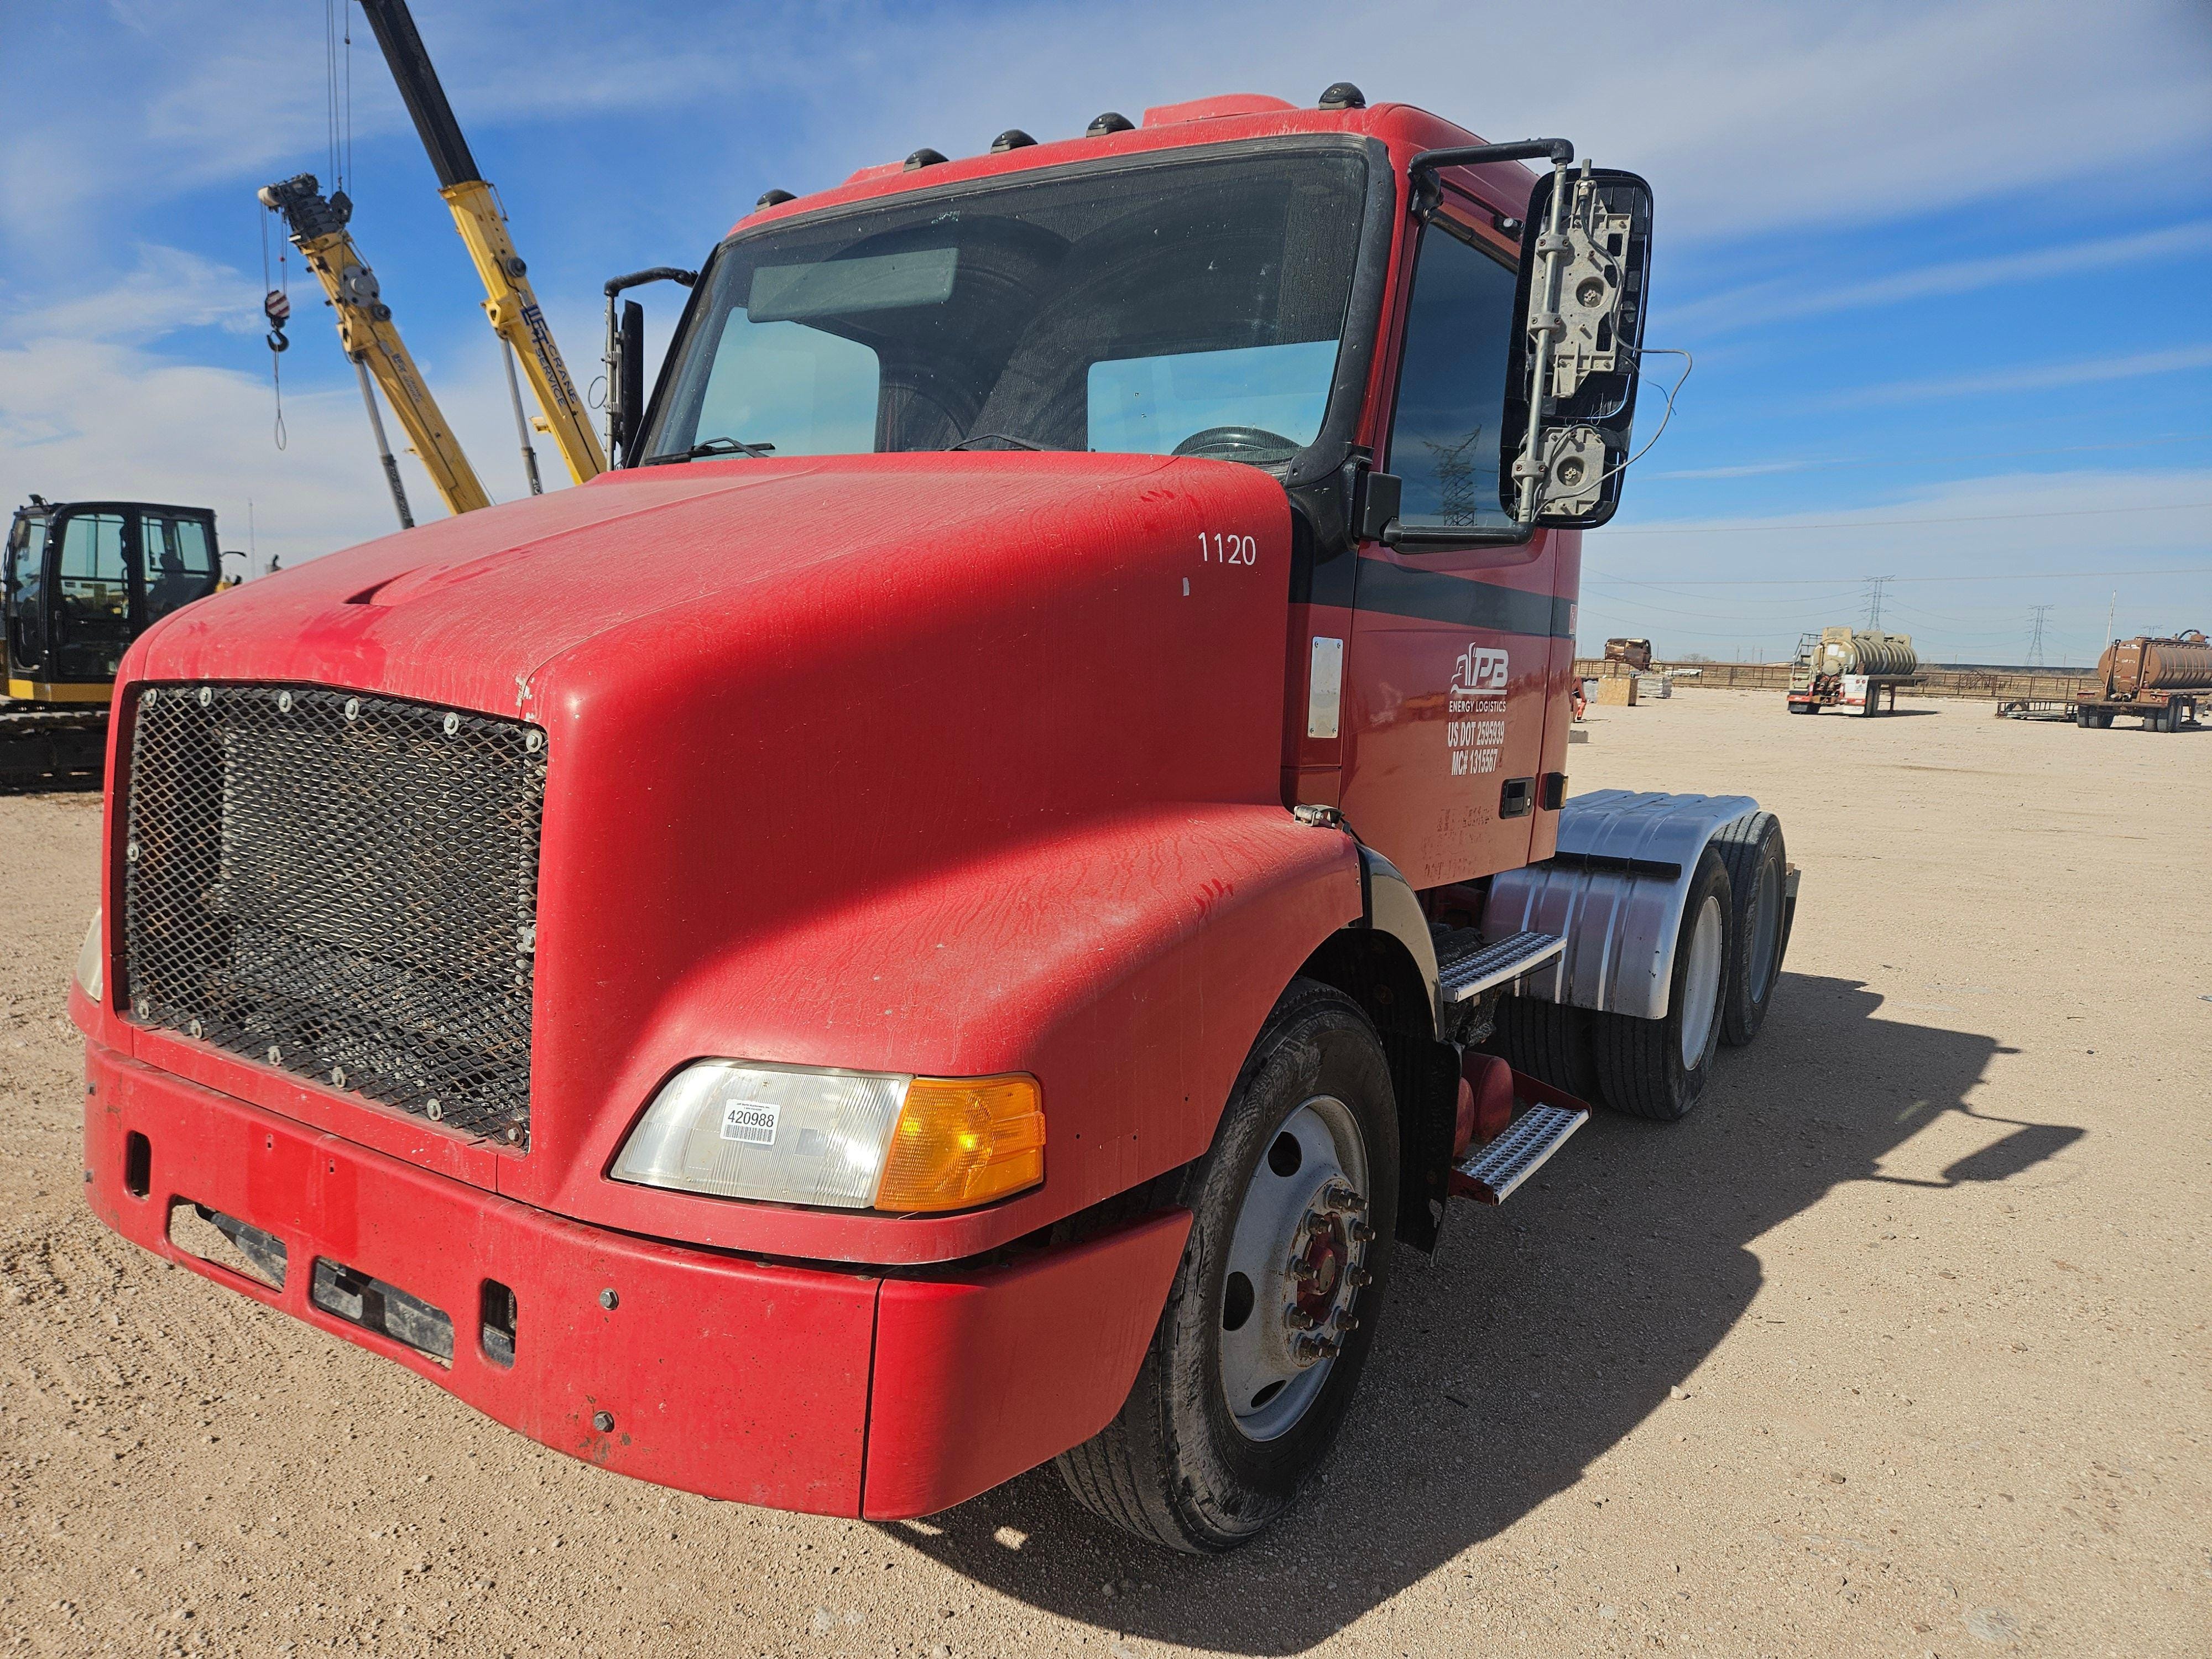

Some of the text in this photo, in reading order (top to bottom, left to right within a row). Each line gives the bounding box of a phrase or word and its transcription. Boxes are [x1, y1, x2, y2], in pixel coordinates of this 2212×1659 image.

[535, 347, 567, 408] SERVICE
[549, 343, 578, 405] CRANE
[1198, 532, 1256, 565] 1120
[1449, 700, 1506, 712] ENERGY LOGISTICS
[1448, 721, 1504, 747] US DOT 2595939
[1451, 748, 1498, 775] MC# 1315567
[728, 1110, 774, 1128] 420988
